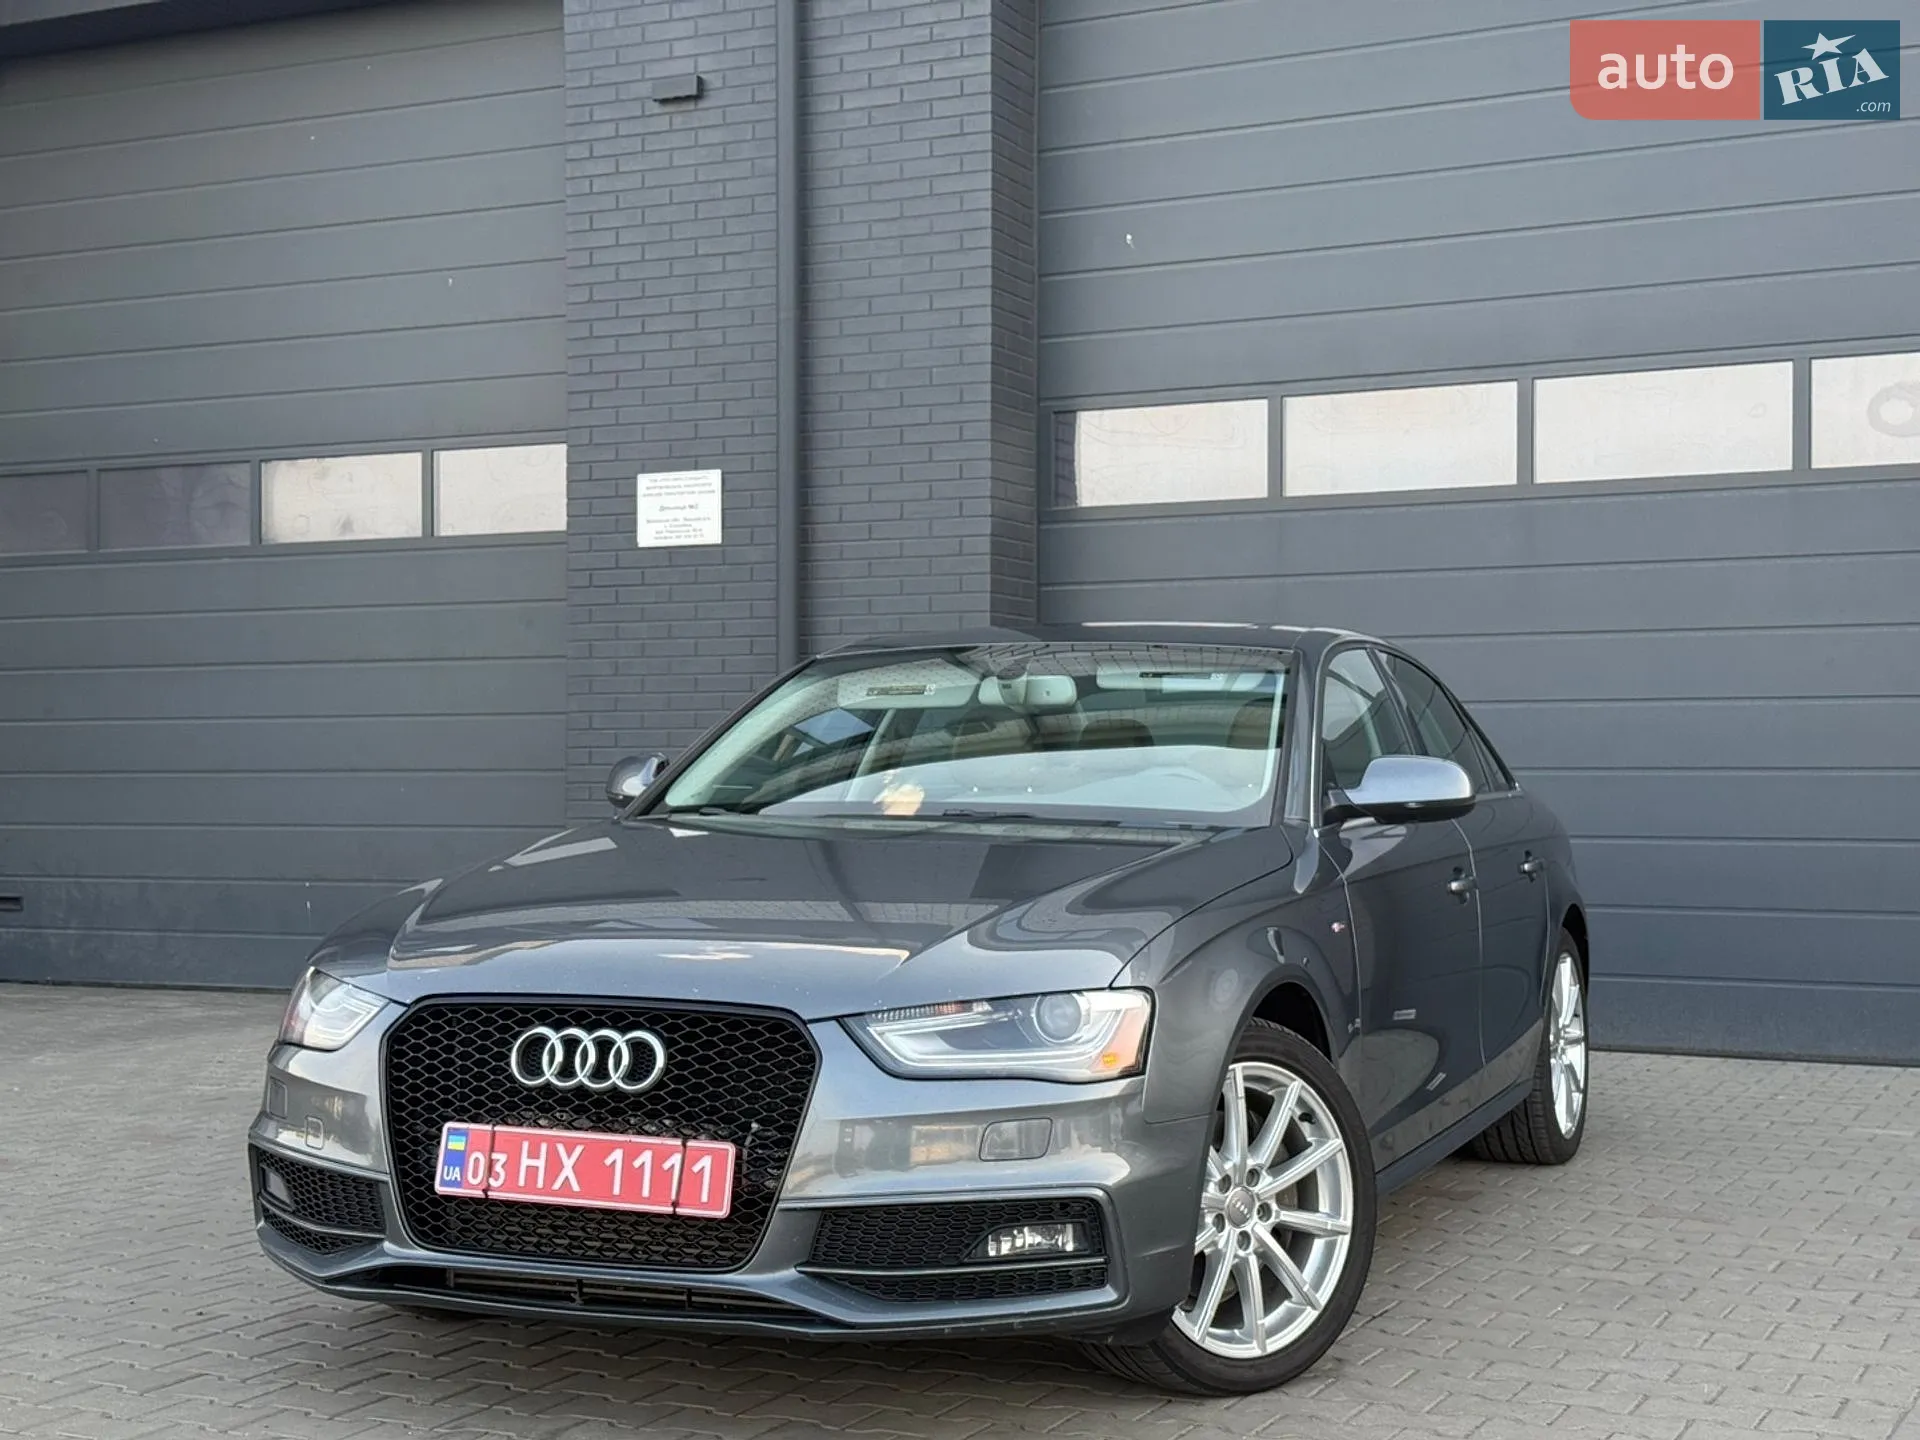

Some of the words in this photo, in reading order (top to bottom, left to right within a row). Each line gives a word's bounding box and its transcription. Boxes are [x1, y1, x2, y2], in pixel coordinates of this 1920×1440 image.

[443, 1165, 462, 1182] UA
[466, 1151, 508, 1188] 03
[517, 1140, 585, 1193] HX
[603, 1148, 713, 1203] 1111
